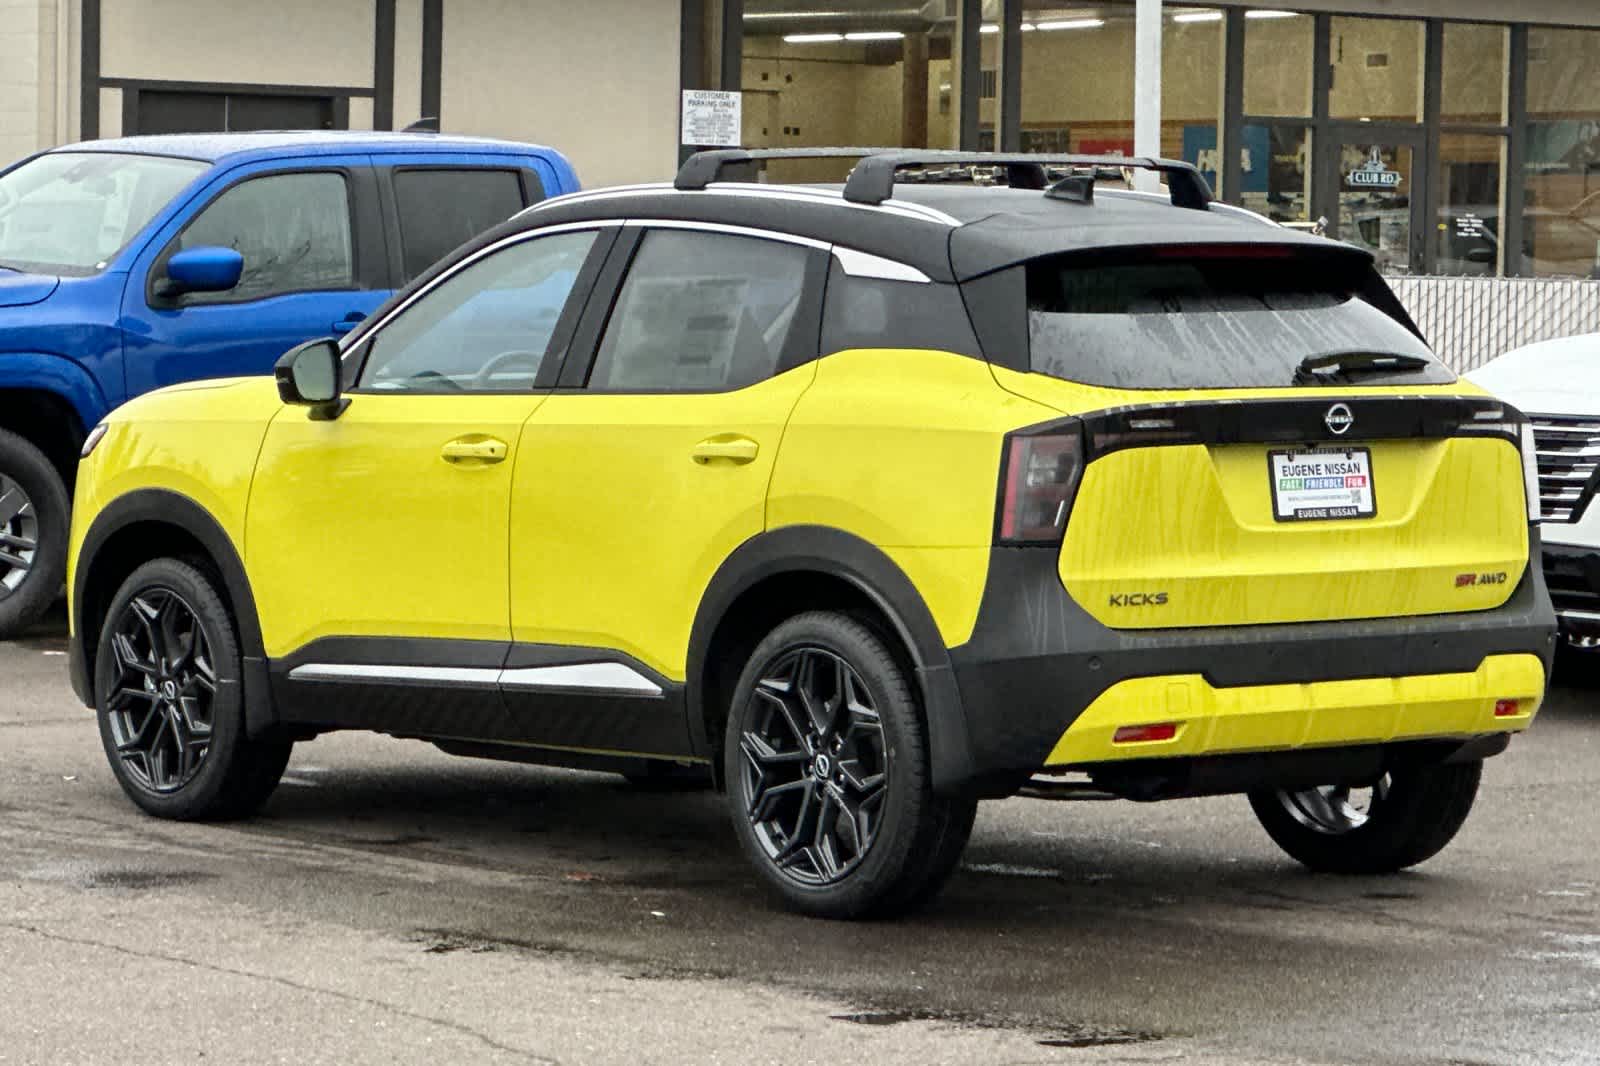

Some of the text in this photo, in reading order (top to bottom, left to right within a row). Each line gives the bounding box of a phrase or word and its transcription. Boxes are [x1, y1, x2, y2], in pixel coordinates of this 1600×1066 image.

[694, 92, 730, 100] CUSTOMER
[1355, 172, 1379, 183] CLUB
[1282, 463, 1361, 477] EUGENE NISSAN
[1298, 507, 1357, 518] EUGENE NISSAN
[1478, 572, 1506, 585] AWD
[1109, 592, 1168, 606] KICKS
